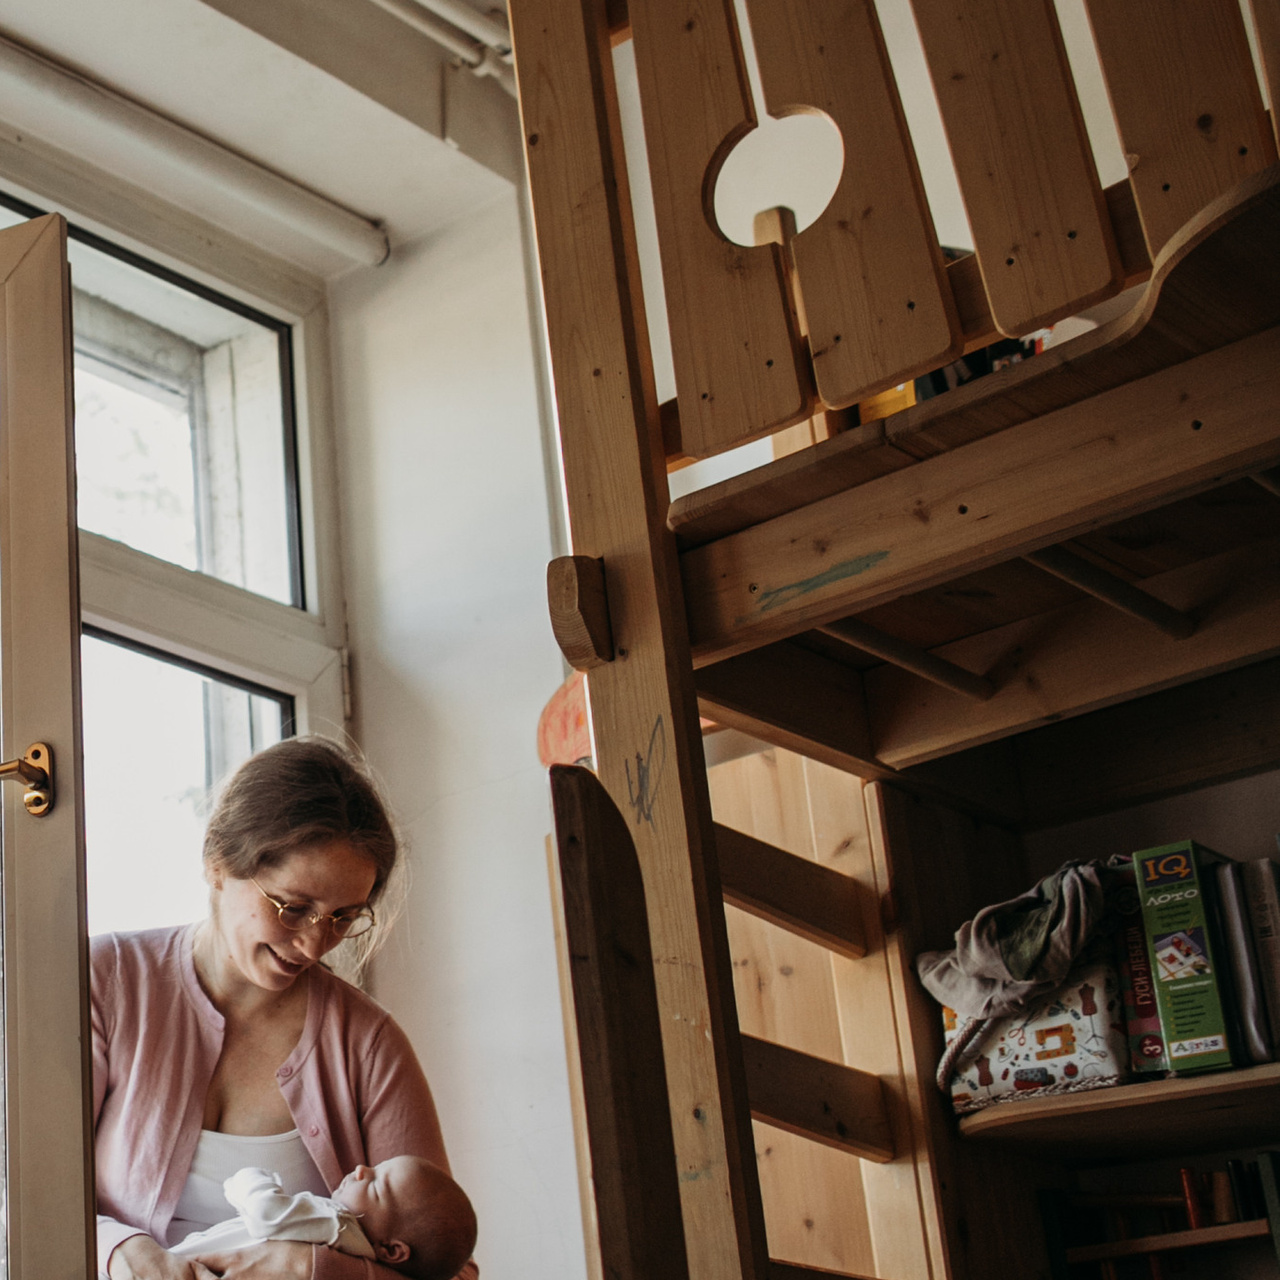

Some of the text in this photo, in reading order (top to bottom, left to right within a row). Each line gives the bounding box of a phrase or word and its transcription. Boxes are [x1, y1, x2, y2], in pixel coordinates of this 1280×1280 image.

[1144, 854, 1192, 881] IQ
[1146, 888, 1200, 907] ЛОТО
[1142, 1037, 1162, 1055] 3+
